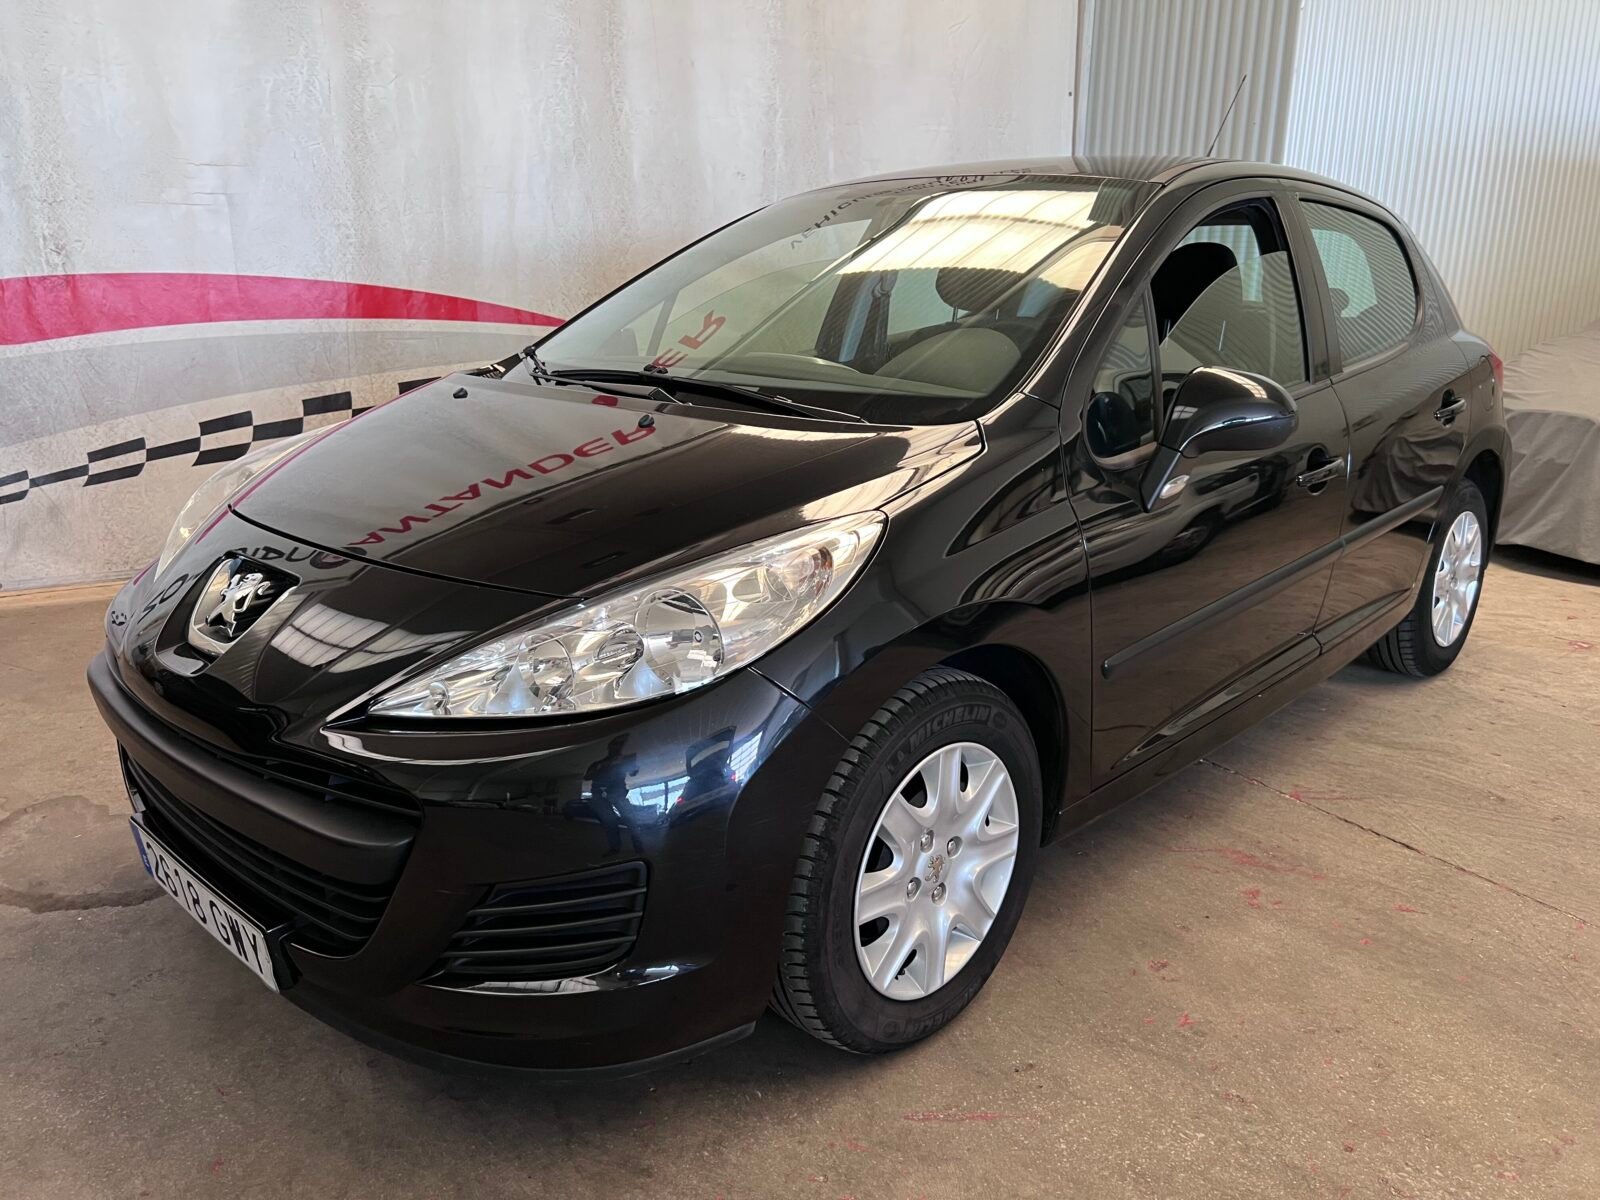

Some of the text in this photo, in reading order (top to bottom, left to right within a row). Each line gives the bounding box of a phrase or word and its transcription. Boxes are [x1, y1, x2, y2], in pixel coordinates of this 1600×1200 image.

[908, 704, 992, 753] MICHELIN
[146, 841, 264, 975] 2618 GWY
